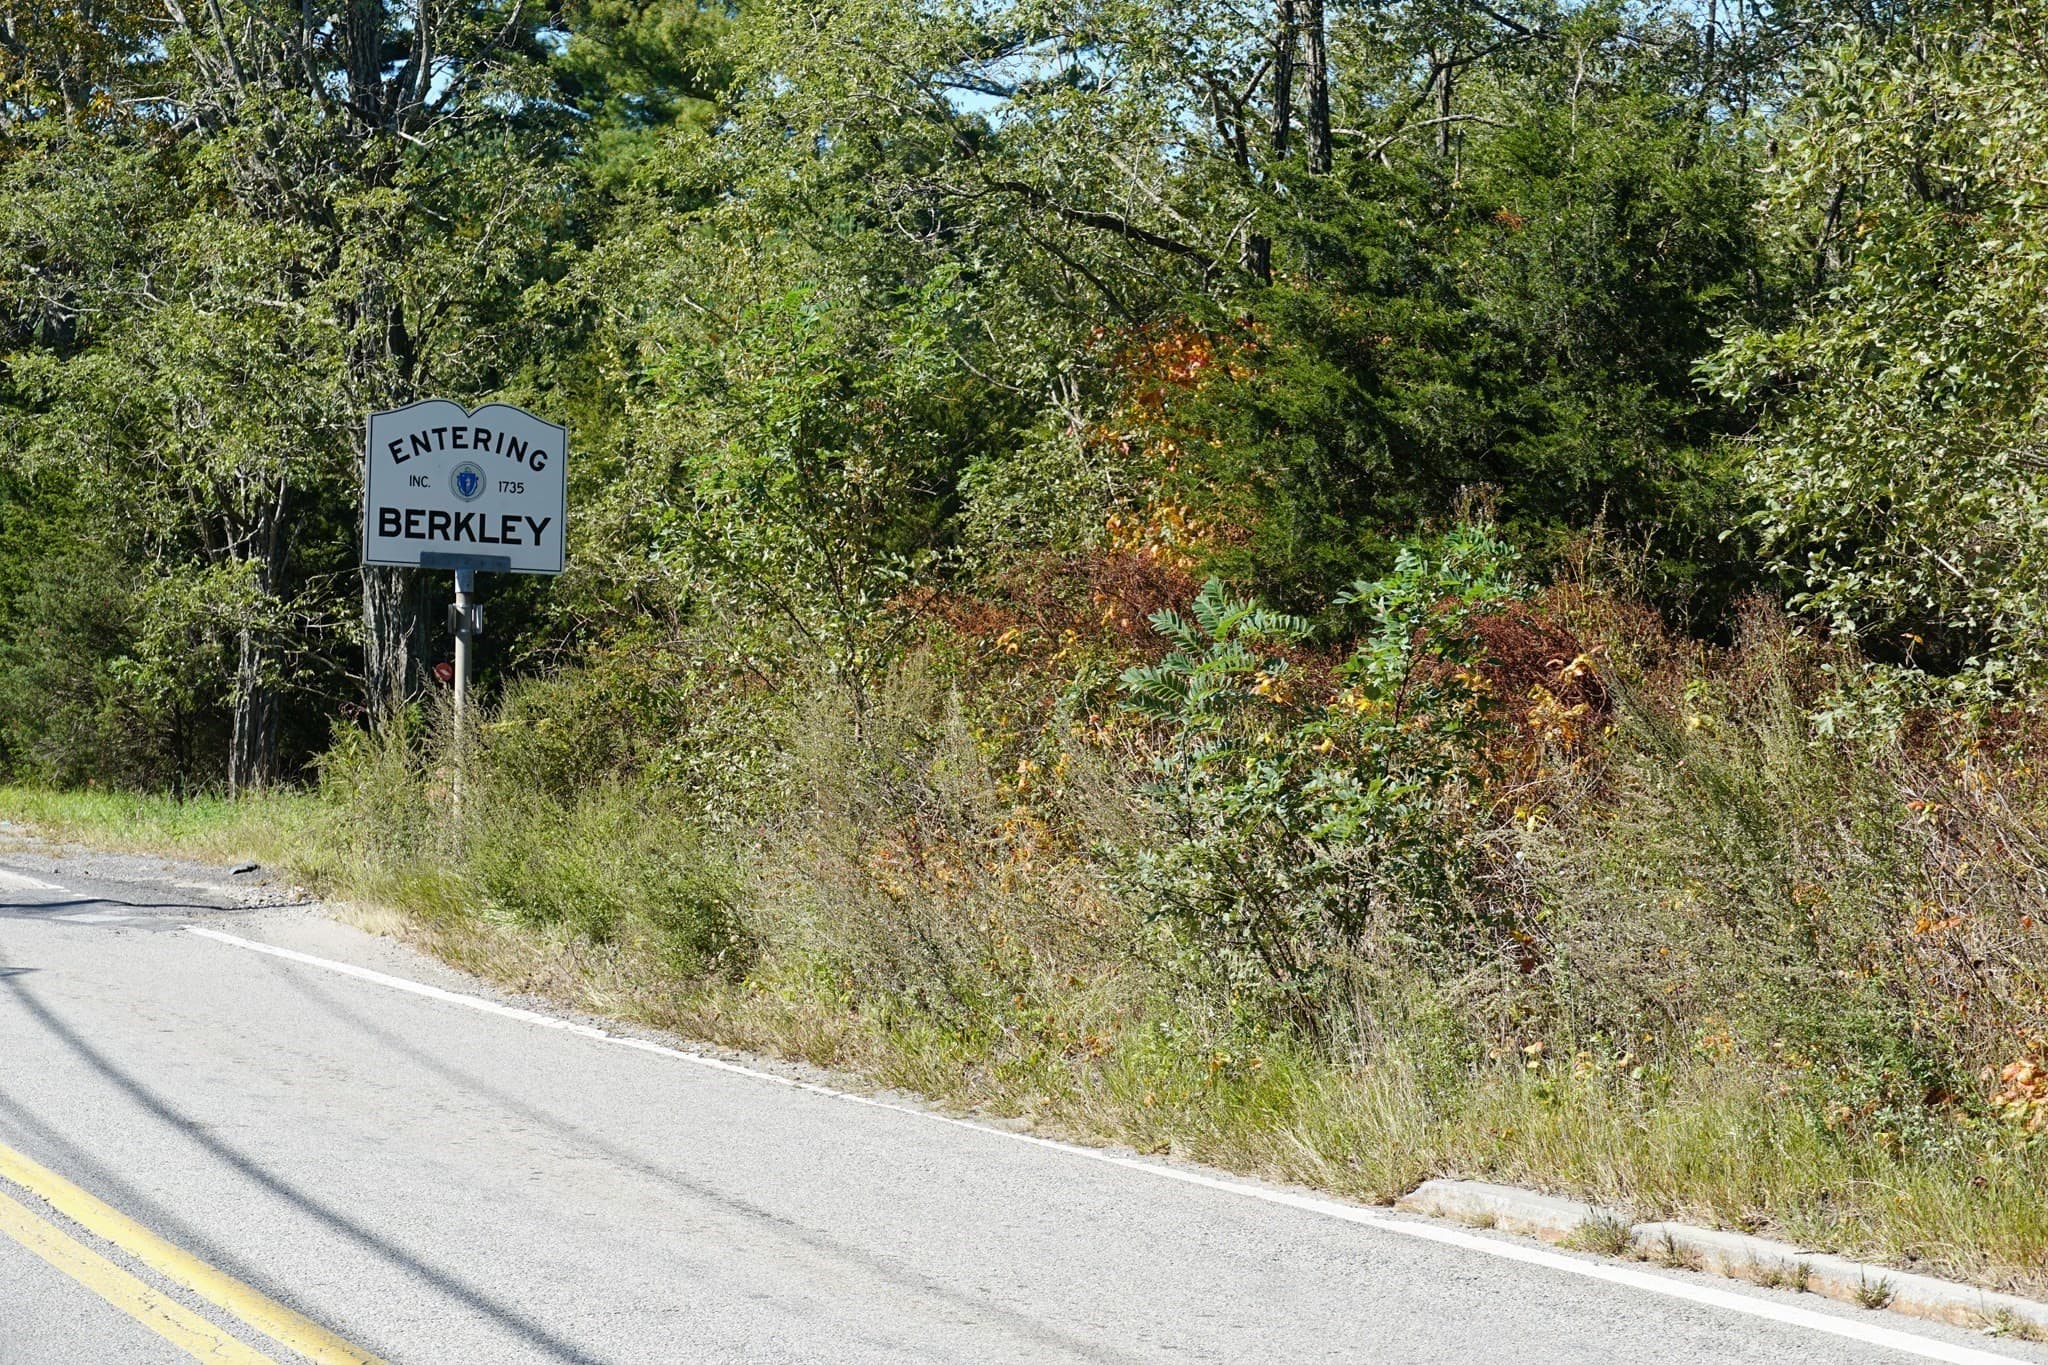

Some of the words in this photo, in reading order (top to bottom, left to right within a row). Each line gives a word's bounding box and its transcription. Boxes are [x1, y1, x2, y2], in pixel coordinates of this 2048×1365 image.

[388, 426, 549, 472] ENTERING
[409, 474, 431, 488] INC.
[498, 480, 525, 494] 1735
[378, 507, 552, 546] BERKLEY
